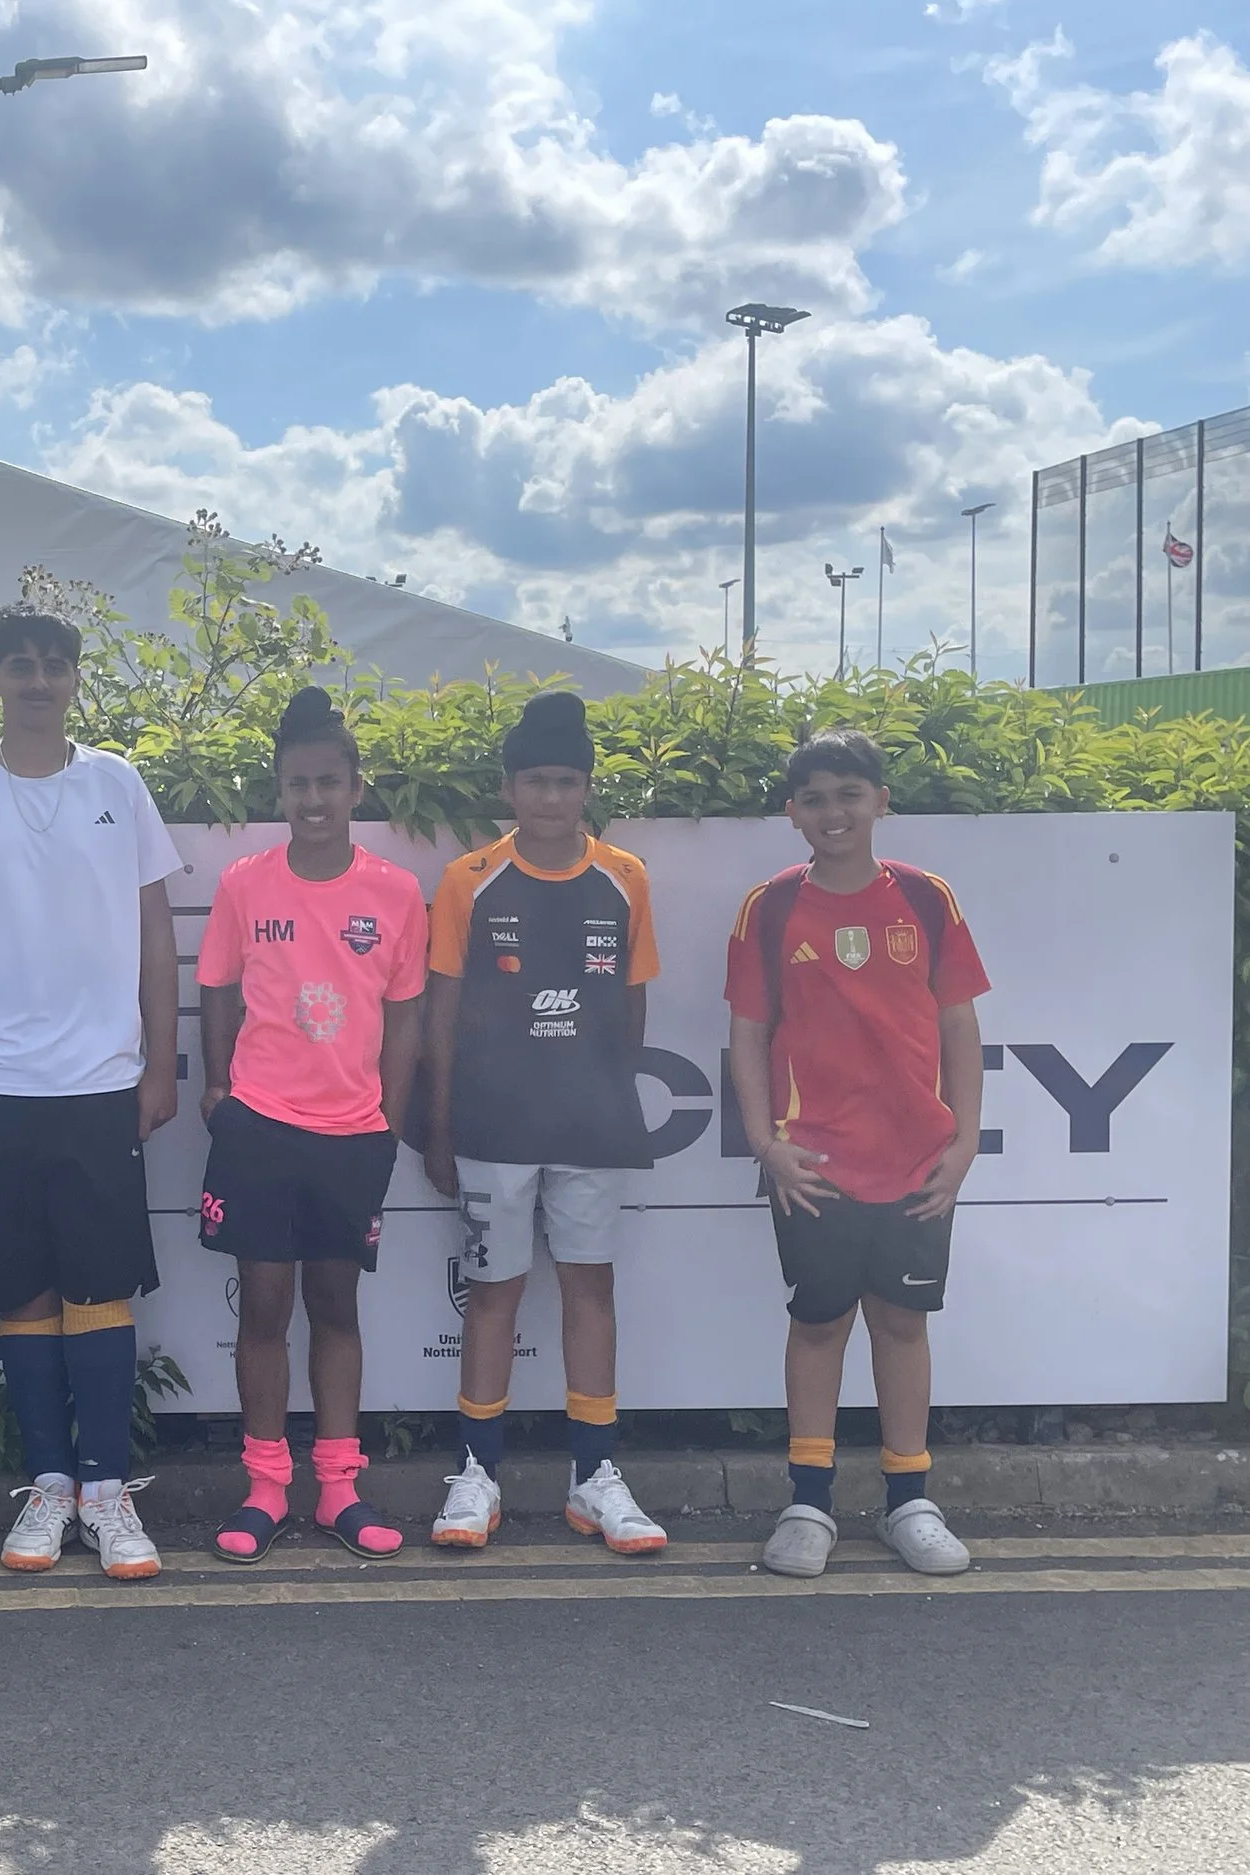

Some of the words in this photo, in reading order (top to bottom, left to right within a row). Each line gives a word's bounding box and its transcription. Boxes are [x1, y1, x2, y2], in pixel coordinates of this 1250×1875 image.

[255, 919, 294, 943] HM
[491, 932, 519, 942] DELL
[531, 988, 580, 1013] ON
[529, 1028, 577, 1038] NUTRITION
[533, 1020, 574, 1030] OPTIMUM
[202, 1191, 225, 1223] 26
